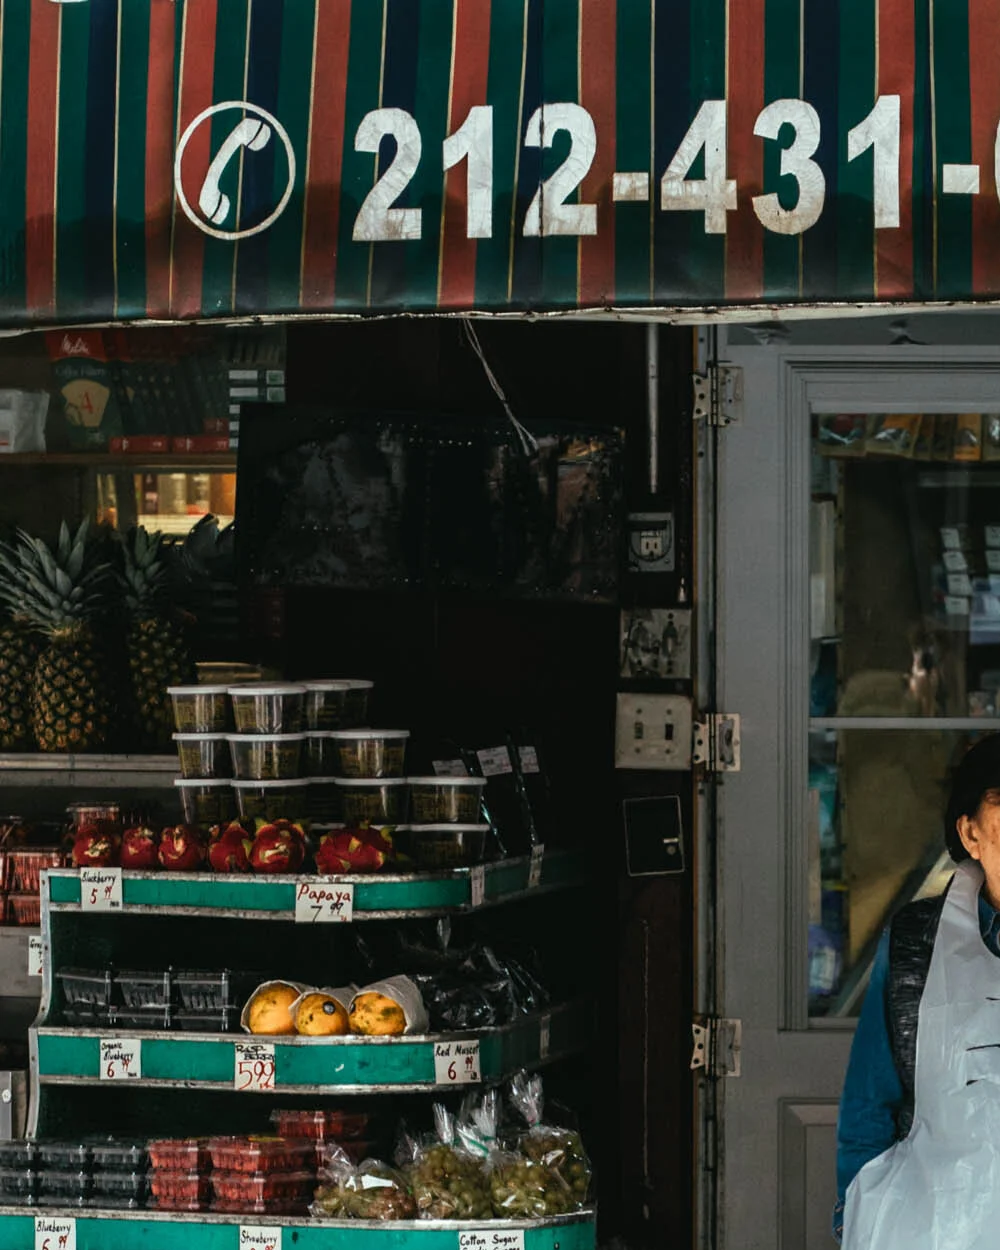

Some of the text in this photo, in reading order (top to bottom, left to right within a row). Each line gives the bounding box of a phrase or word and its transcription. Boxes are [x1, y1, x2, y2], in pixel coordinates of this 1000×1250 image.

[81, 871, 116, 887] Blackberry
[89, 887, 98, 904] 5
[297, 883, 351, 903] Papaya
[310, 902, 344, 923] 7 99
[436, 1044, 451, 1056] Red
[107, 1061, 114, 1078] 6
[448, 1060, 456, 1080] 6
[36, 1219, 71, 1235] Blueberry
[58, 1235, 68, 1249] 99
[460, 1234, 517, 1246] Cotton Sugar
